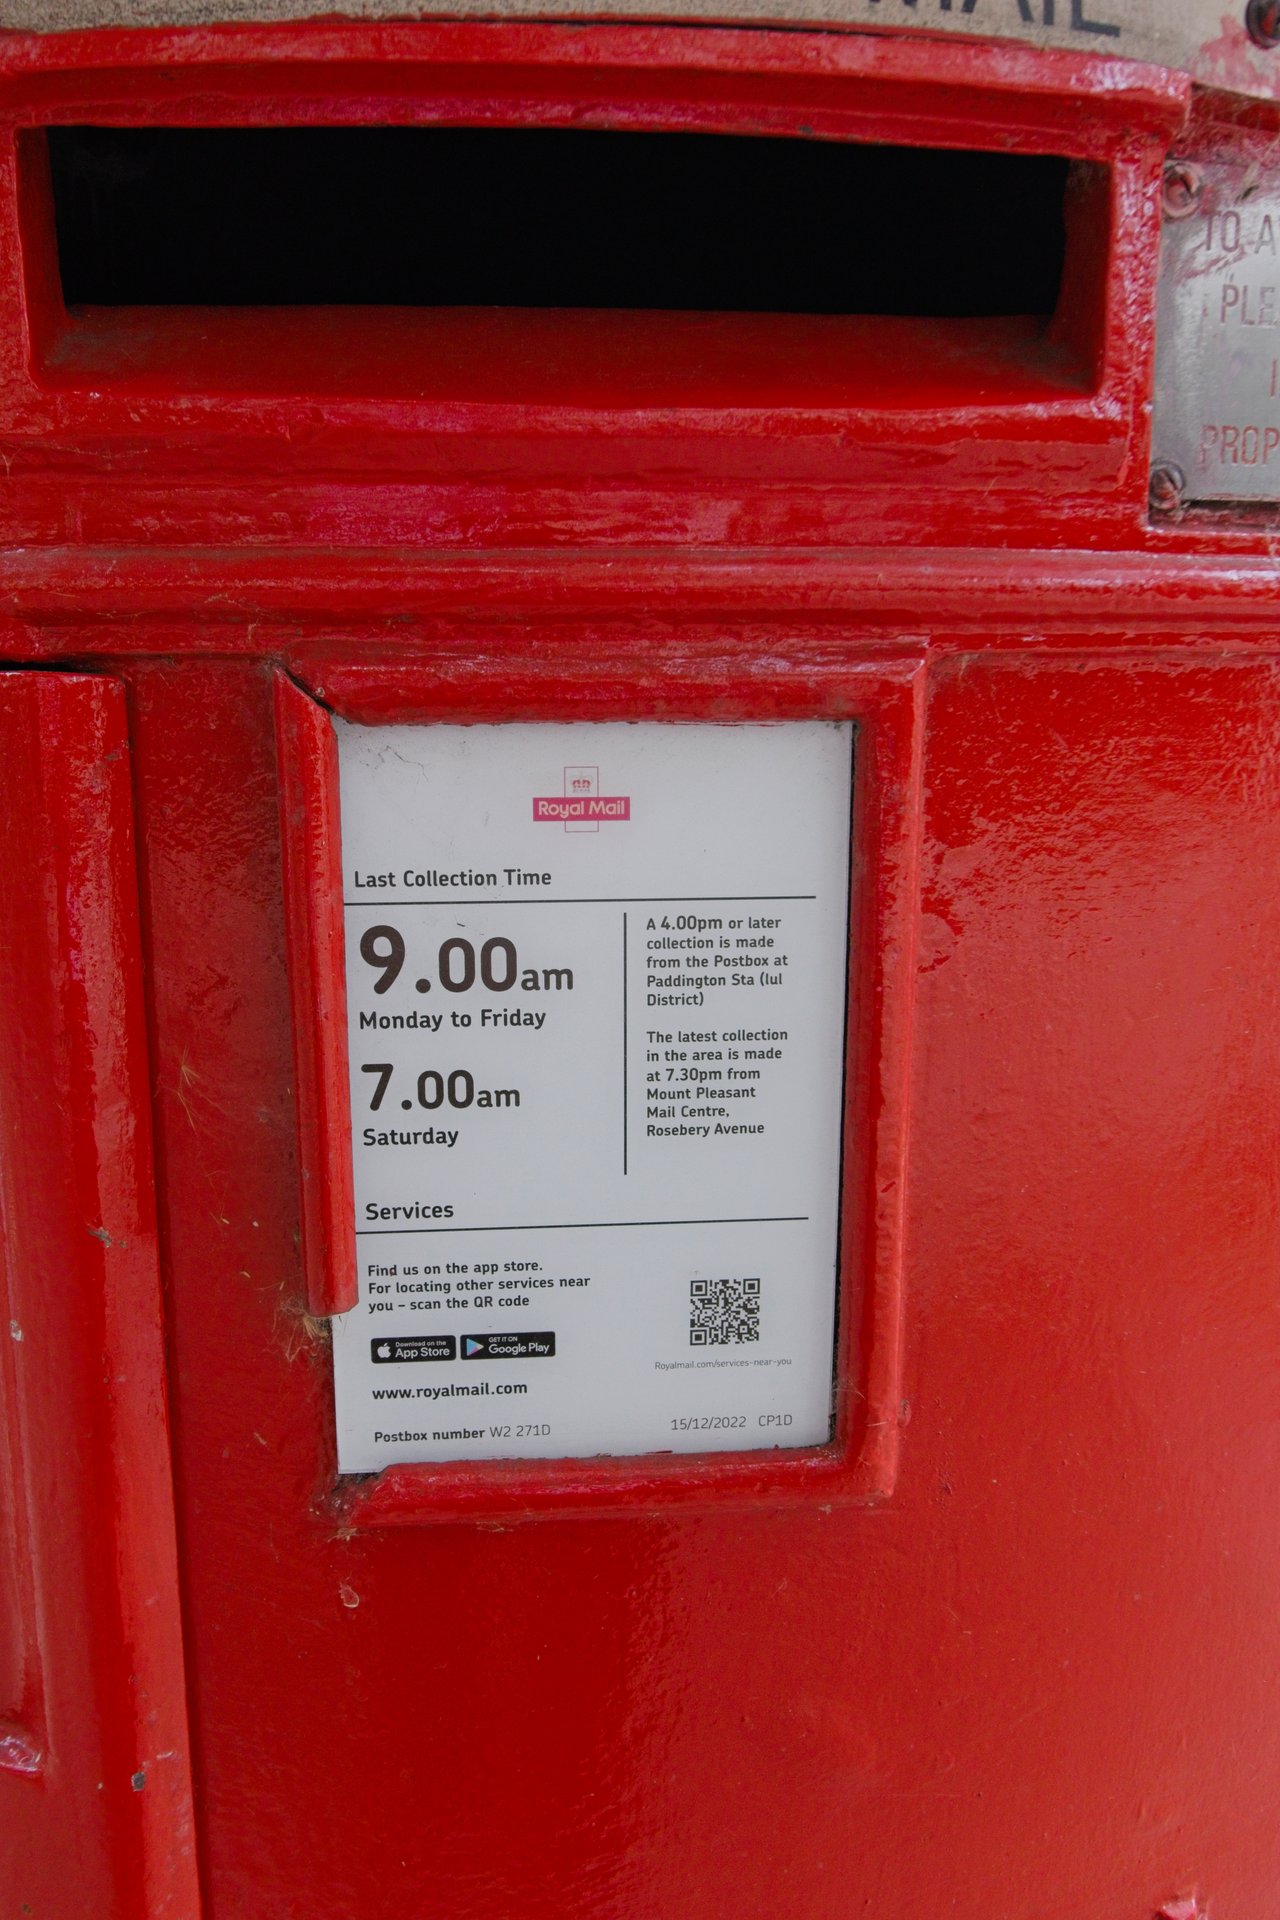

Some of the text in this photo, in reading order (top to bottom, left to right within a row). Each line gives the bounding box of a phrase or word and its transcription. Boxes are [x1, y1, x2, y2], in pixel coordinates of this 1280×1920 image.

[1205, 210, 1280, 255] TO A
[1220, 284, 1280, 327] PLE
[538, 800, 625, 819] Royal Mail
[354, 868, 552, 888] Last Collection Time
[646, 914, 782, 933] A 4.00pm or later
[646, 936, 775, 949] collection is made
[360, 924, 574, 995] 9.00am
[646, 955, 789, 969] from the Postbox at
[646, 974, 727, 989] Paddington
[731, 973, 755, 986] Sta
[646, 992, 704, 1006] District)
[360, 1008, 547, 1032] Monday to Friday
[646, 1029, 788, 1043] The latest collection
[646, 1047, 783, 1062] in the area is made
[646, 1067, 761, 1083] at 7.30pm from
[360, 1062, 521, 1111] 7.00am
[646, 1087, 757, 1101] Mount Pleasant
[646, 1105, 730, 1119] Mail Centre,
[362, 1128, 460, 1147] Saturday
[646, 1123, 765, 1138] Rosebery Avenue
[365, 1201, 454, 1221] Services
[367, 1261, 543, 1276] Find us on the app store.
[368, 1277, 591, 1295] For locating other services near
[368, 1303, 394, 1315] you
[409, 1301, 441, 1311] scan
[445, 1297, 469, 1309] the
[473, 1296, 494, 1309] QR
[498, 1294, 530, 1306] code
[395, 1347, 450, 1360] App Store
[488, 1342, 550, 1355] Google Play
[654, 1358, 792, 1372] Royalmail.com/services-near-you
[372, 1382, 528, 1401] www.royalmail.com
[671, 1414, 793, 1431] 15/12/2022 CP1D
[374, 1424, 551, 1443] Postbox number W2 271D
